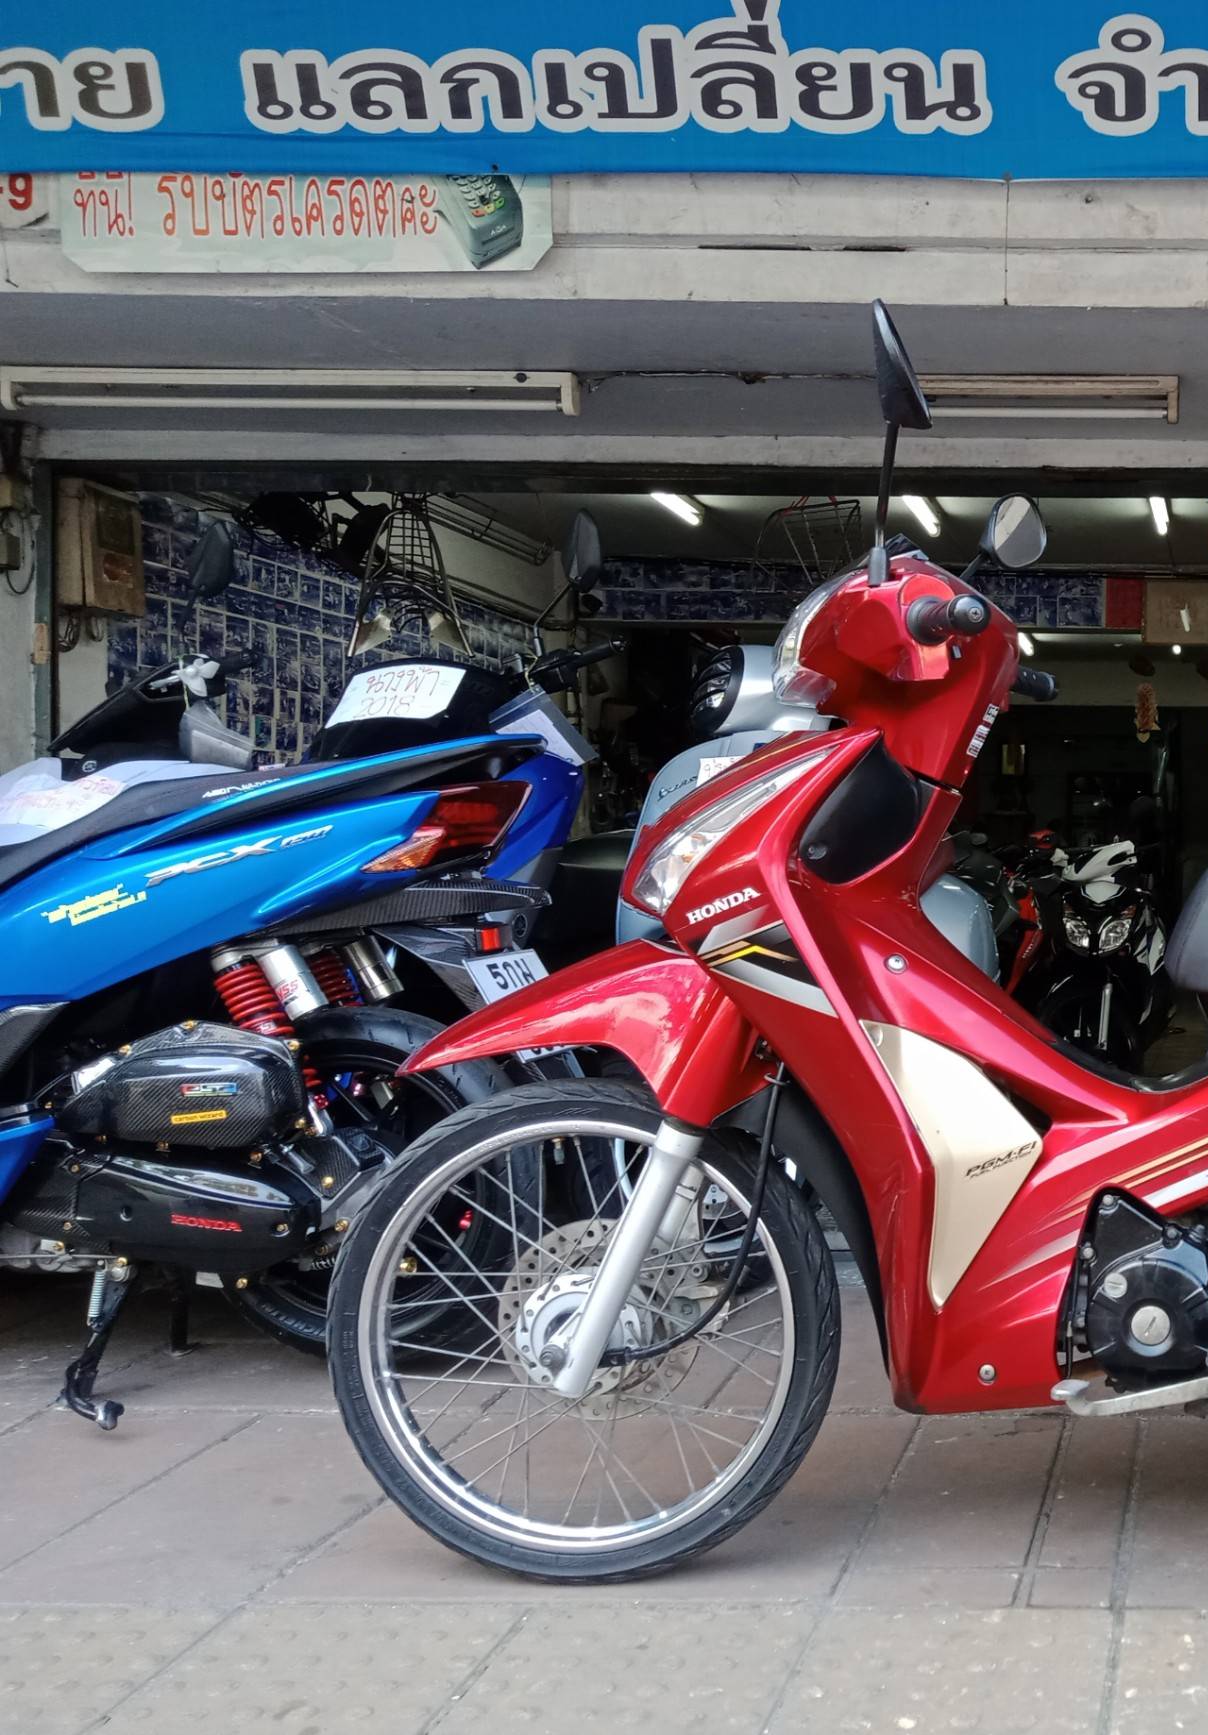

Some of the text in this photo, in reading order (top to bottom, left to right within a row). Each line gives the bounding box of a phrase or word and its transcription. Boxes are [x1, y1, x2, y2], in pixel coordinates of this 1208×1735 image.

[252, 0, 982, 122] แลกเปลี่ยน
[144, 835, 283, 889] PCX
[686, 887, 763, 925] HONDA
[171, 1214, 243, 1232] HONDA
